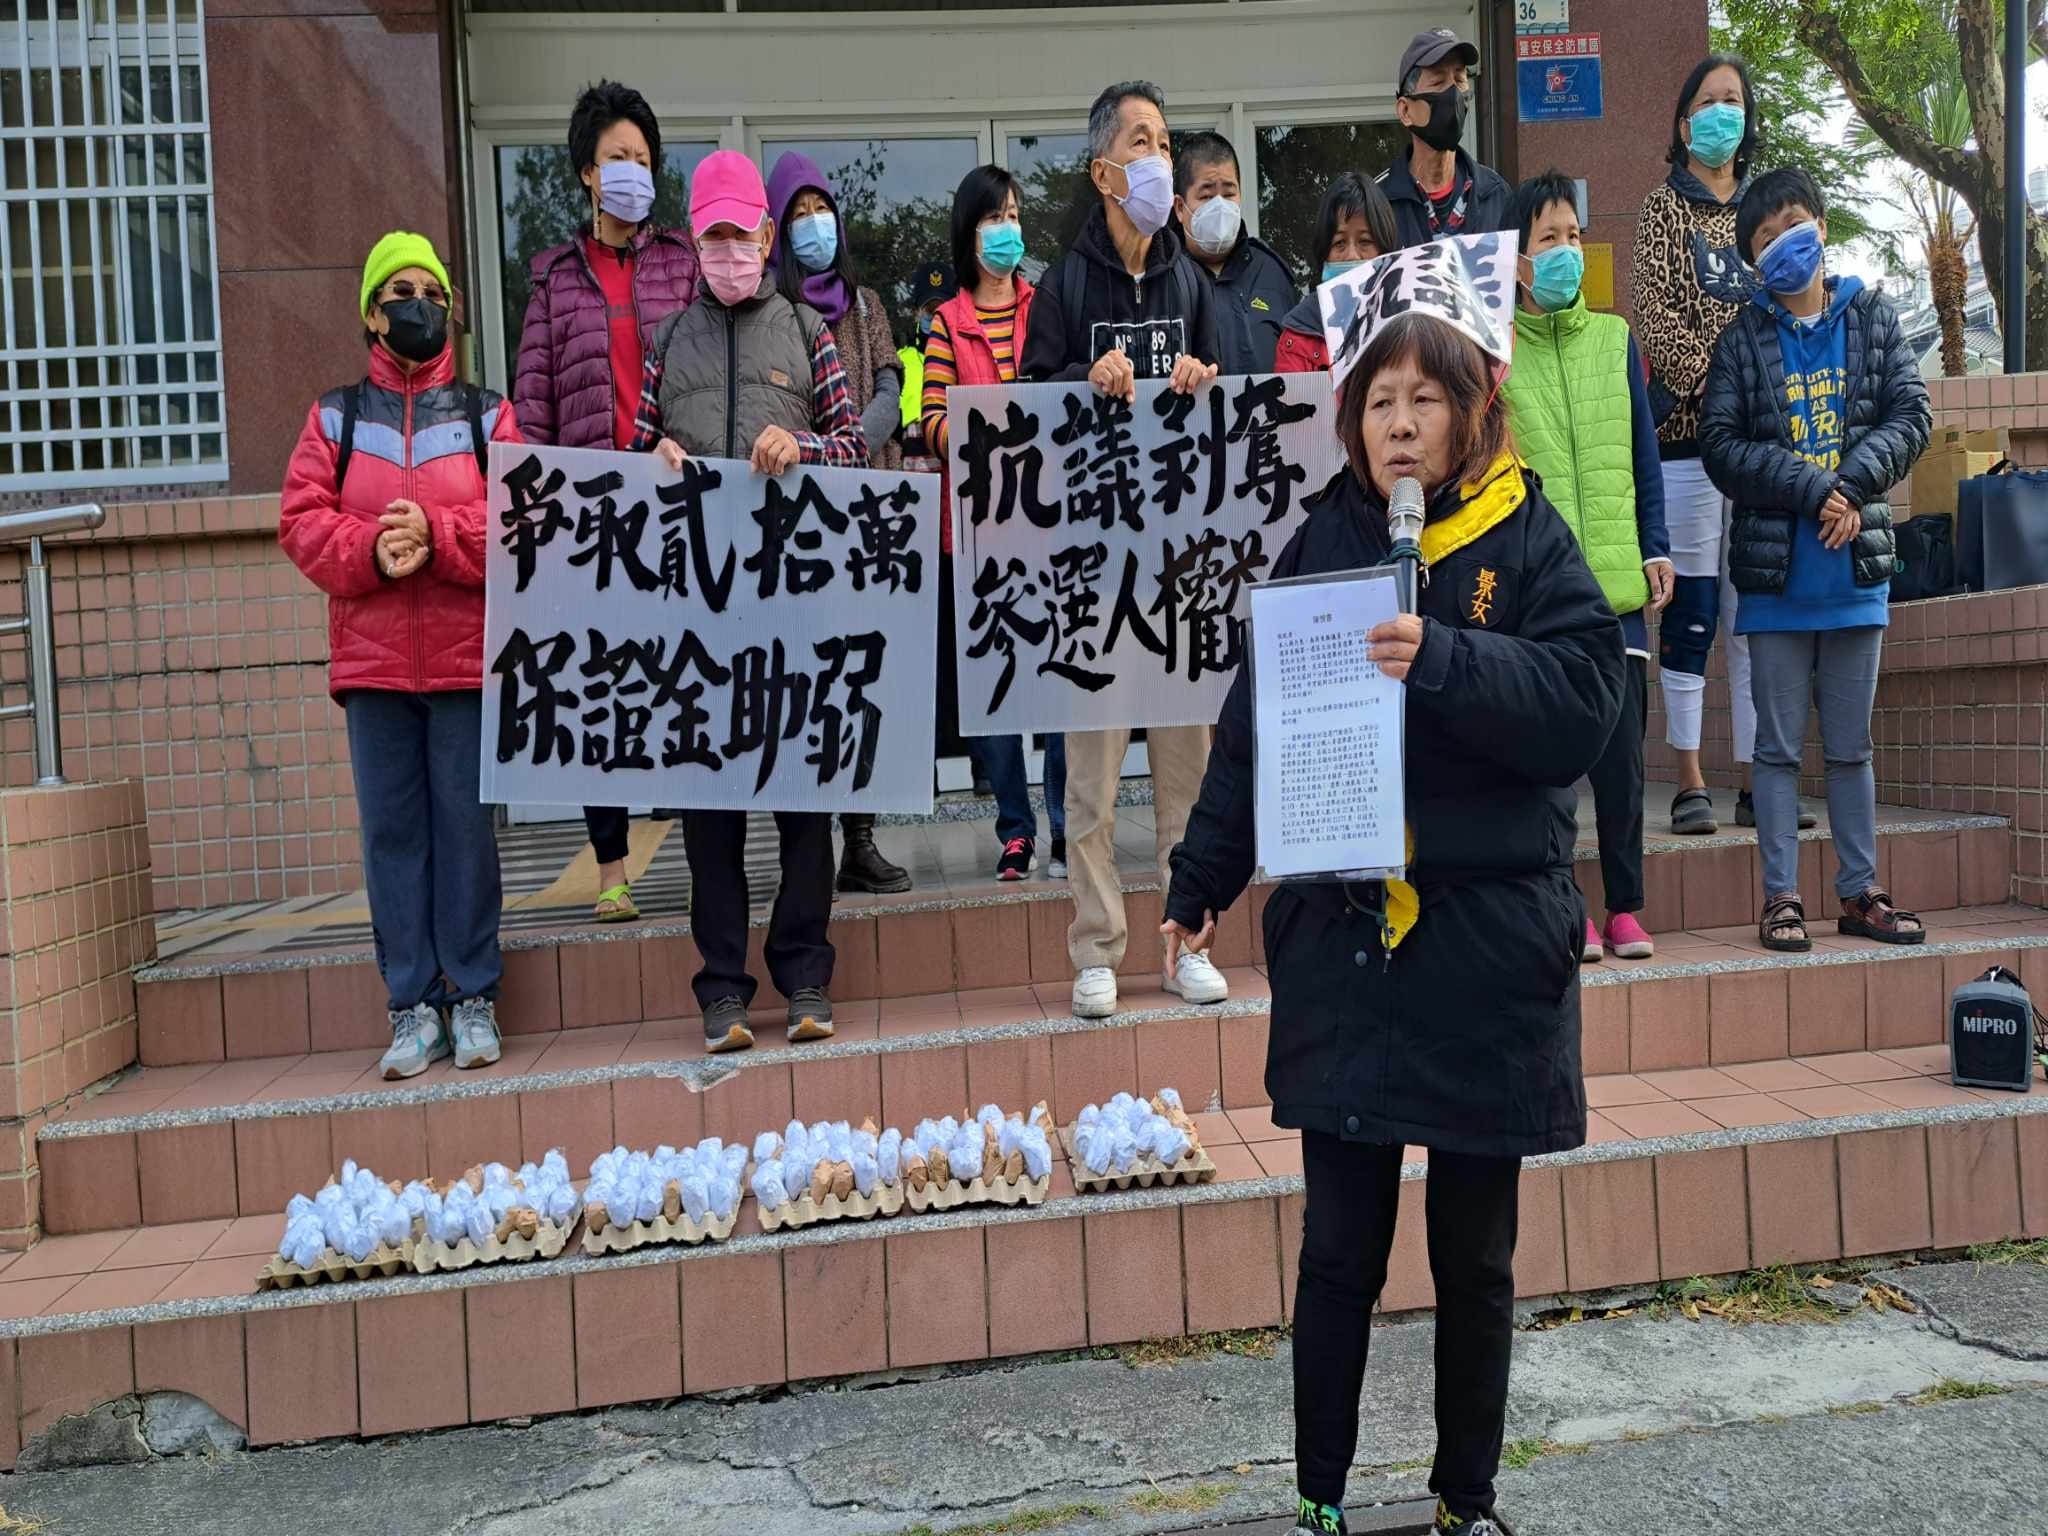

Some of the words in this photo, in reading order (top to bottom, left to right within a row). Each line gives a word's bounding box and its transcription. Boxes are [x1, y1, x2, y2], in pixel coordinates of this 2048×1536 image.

[1519, 3, 1537, 20] 36
[1151, 331, 1167, 351] 89
[500, 453, 923, 613] 爭取貳拾萬
[491, 627, 887, 798] 保證金助弱
[1962, 1016, 2018, 1035] MIPRO
